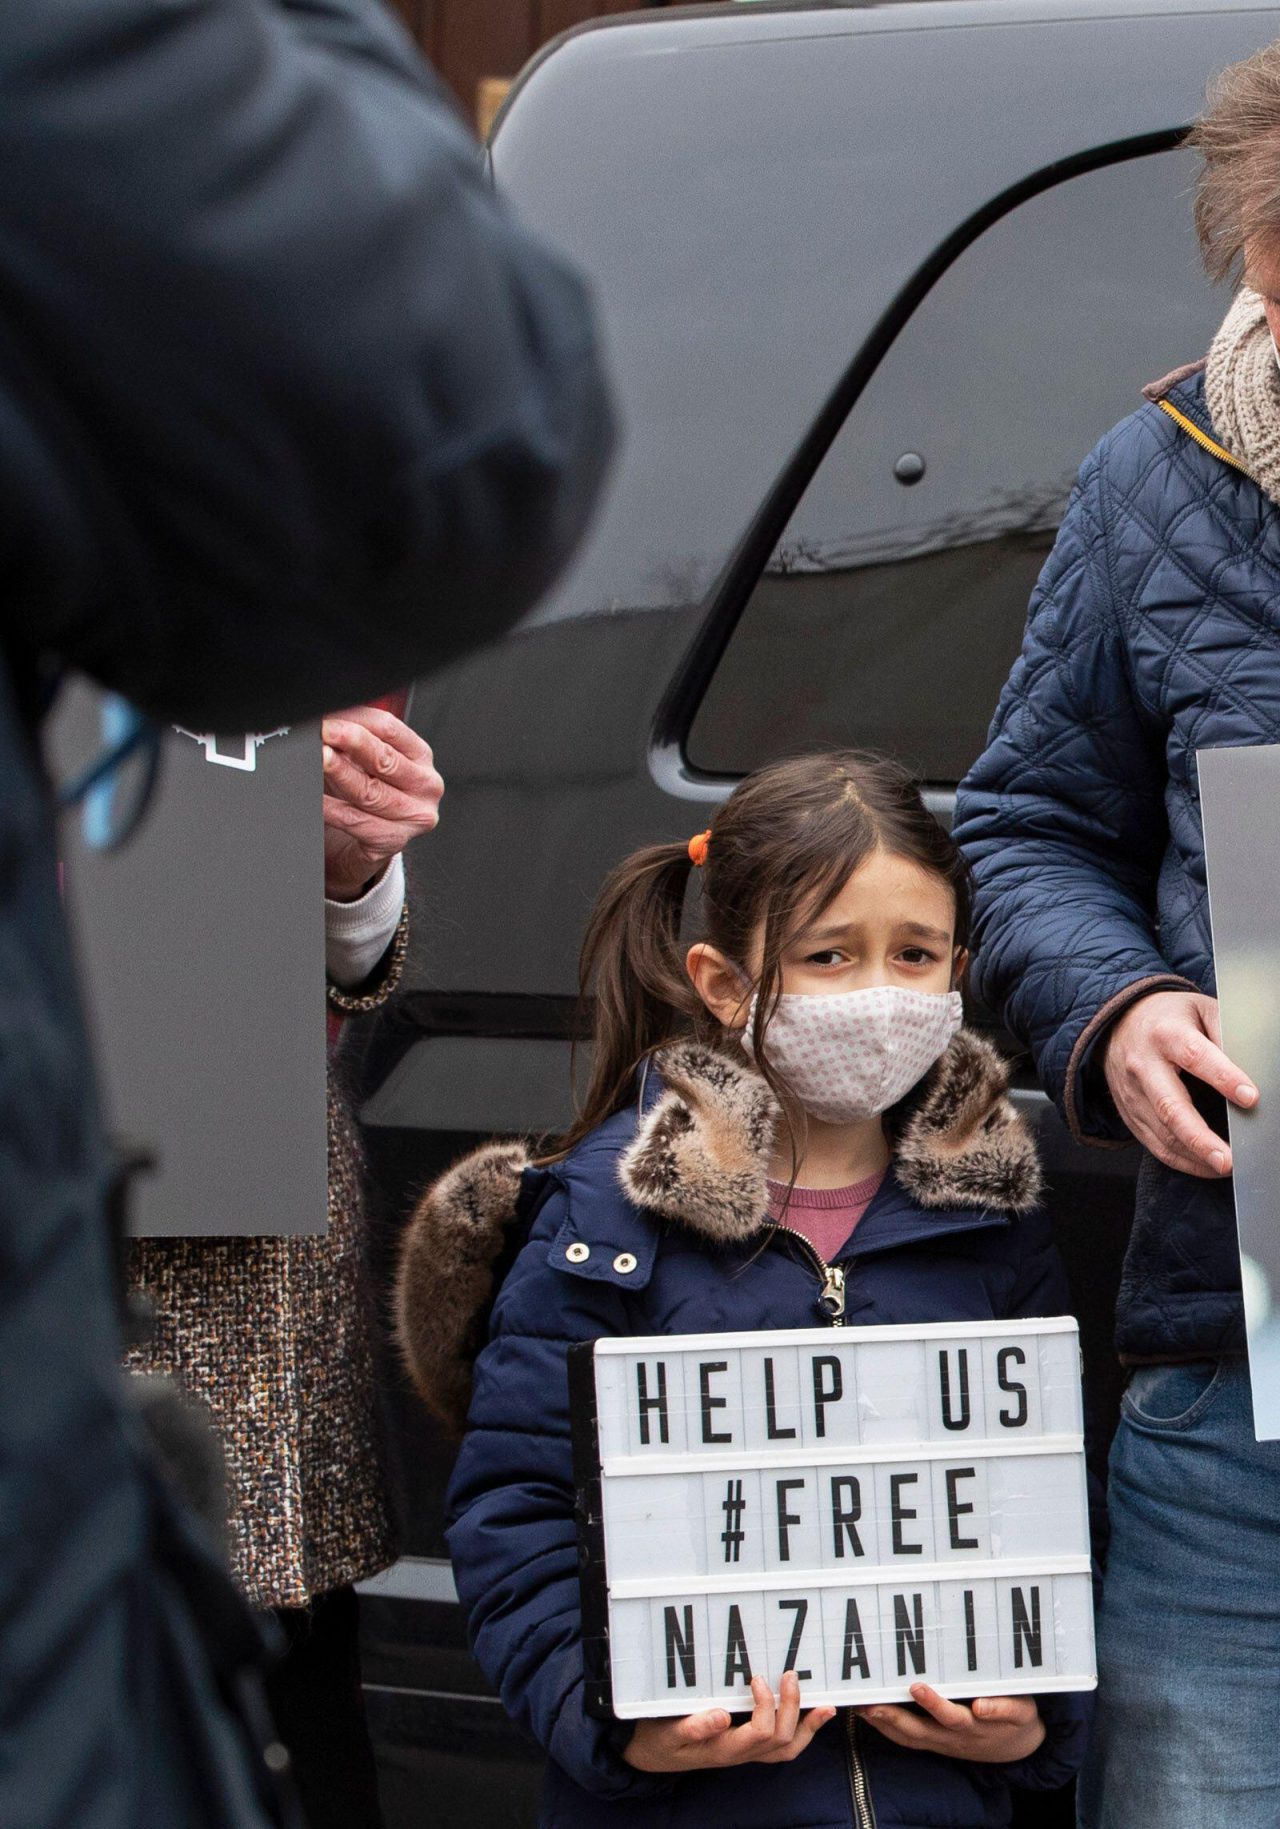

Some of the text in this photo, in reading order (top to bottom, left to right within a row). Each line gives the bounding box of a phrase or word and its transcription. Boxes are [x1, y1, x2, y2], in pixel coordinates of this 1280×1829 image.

[637, 1346, 1028, 1445] HELP US
[721, 1467, 979, 1563] #FREE
[664, 1586, 1043, 1689] NAZANIN
